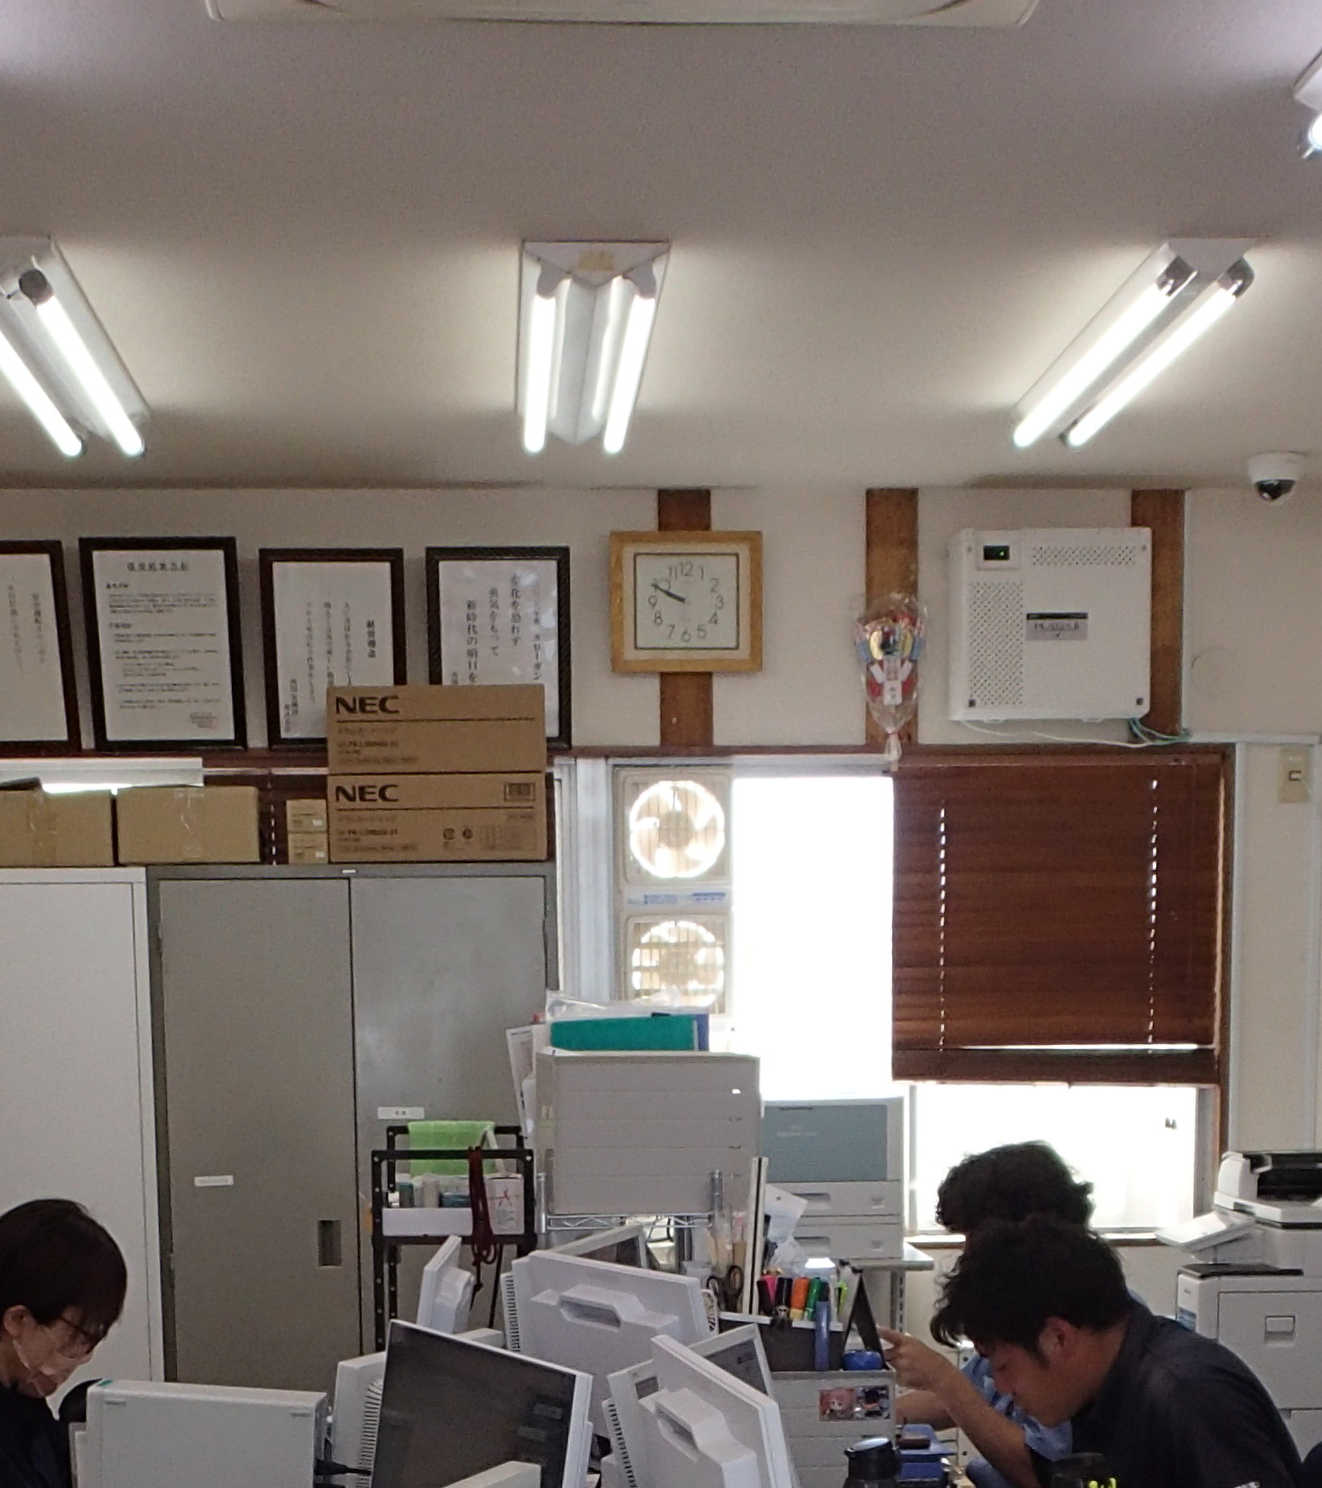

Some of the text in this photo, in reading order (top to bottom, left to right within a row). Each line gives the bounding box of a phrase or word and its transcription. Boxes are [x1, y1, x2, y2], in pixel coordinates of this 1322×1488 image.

[680, 561, 694, 577] 12
[710, 578, 719, 593] 2
[648, 595, 658, 609] 9
[716, 595, 724, 610] 3
[654, 611, 663, 627] 8
[709, 612, 718, 625] 4
[668, 624, 676, 639] 7
[681, 629, 691, 643] 6
[697, 623, 707, 639] 5
[335, 695, 401, 715] NEC
[334, 784, 400, 803] NEC
